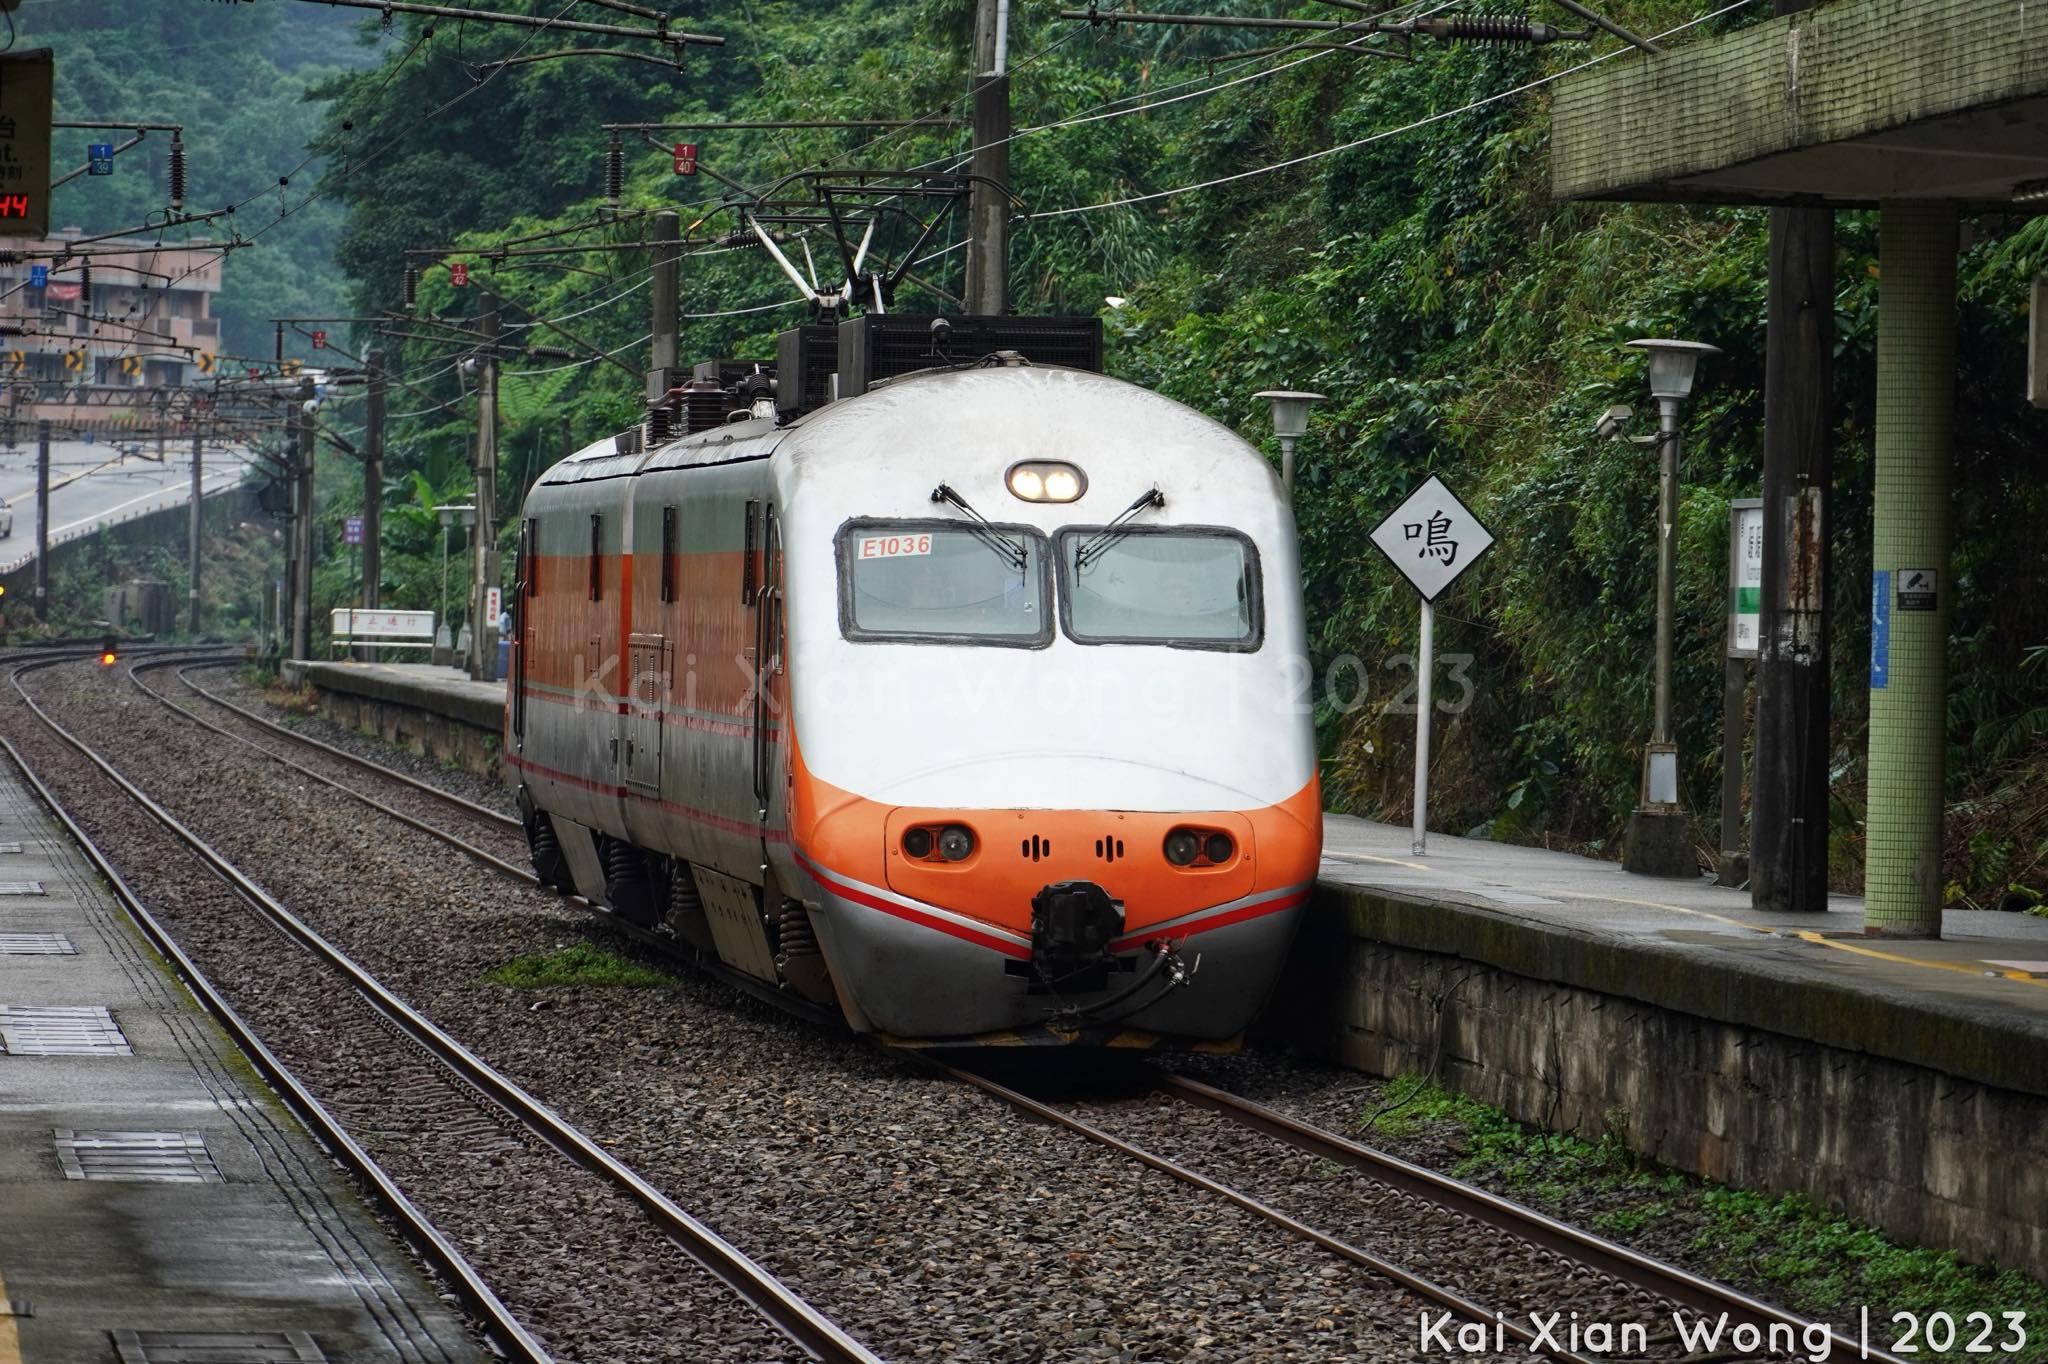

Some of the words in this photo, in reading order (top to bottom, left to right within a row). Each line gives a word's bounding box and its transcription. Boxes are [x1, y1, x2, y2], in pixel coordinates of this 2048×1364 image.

[678, 160, 690, 173] 40
[863, 536, 930, 558] E1036
[1403, 509, 1459, 567] 鳴
